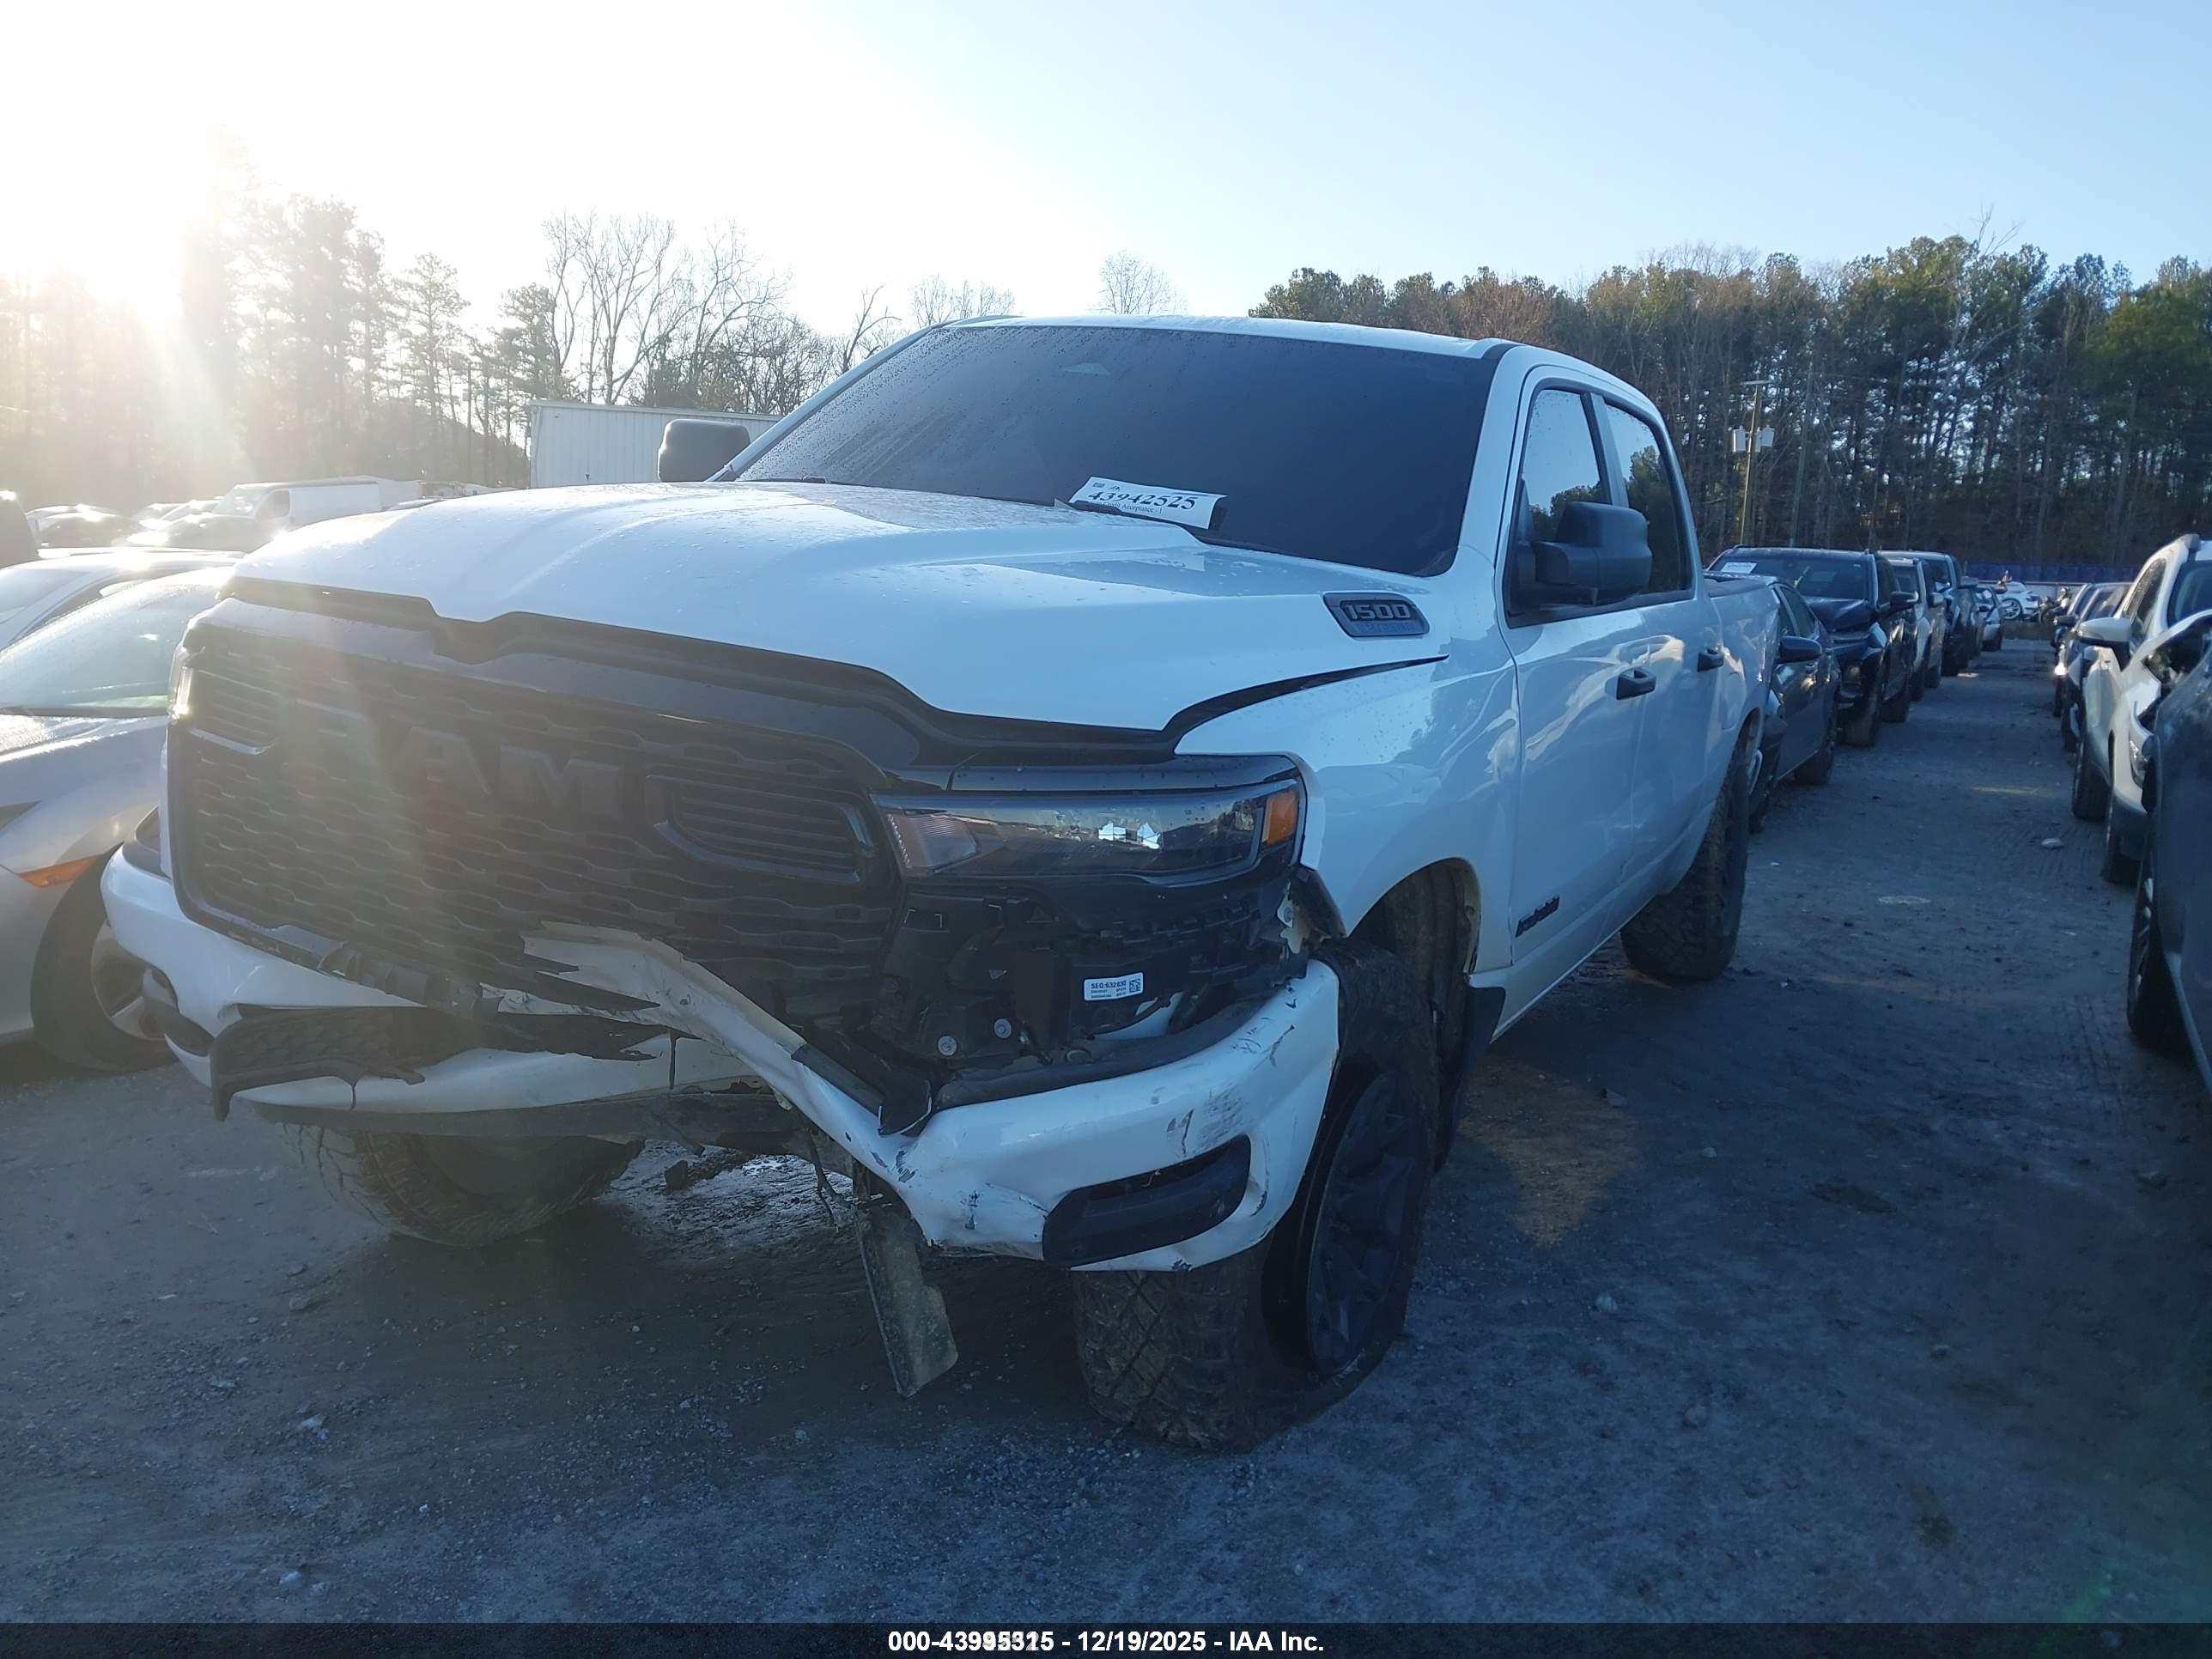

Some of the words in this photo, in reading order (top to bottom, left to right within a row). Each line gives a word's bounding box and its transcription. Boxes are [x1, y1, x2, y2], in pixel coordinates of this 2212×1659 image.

[1088, 490, 1200, 510] 43942525
[1121, 503, 1155, 513] Acceptance
[1346, 604, 1411, 620] 1500
